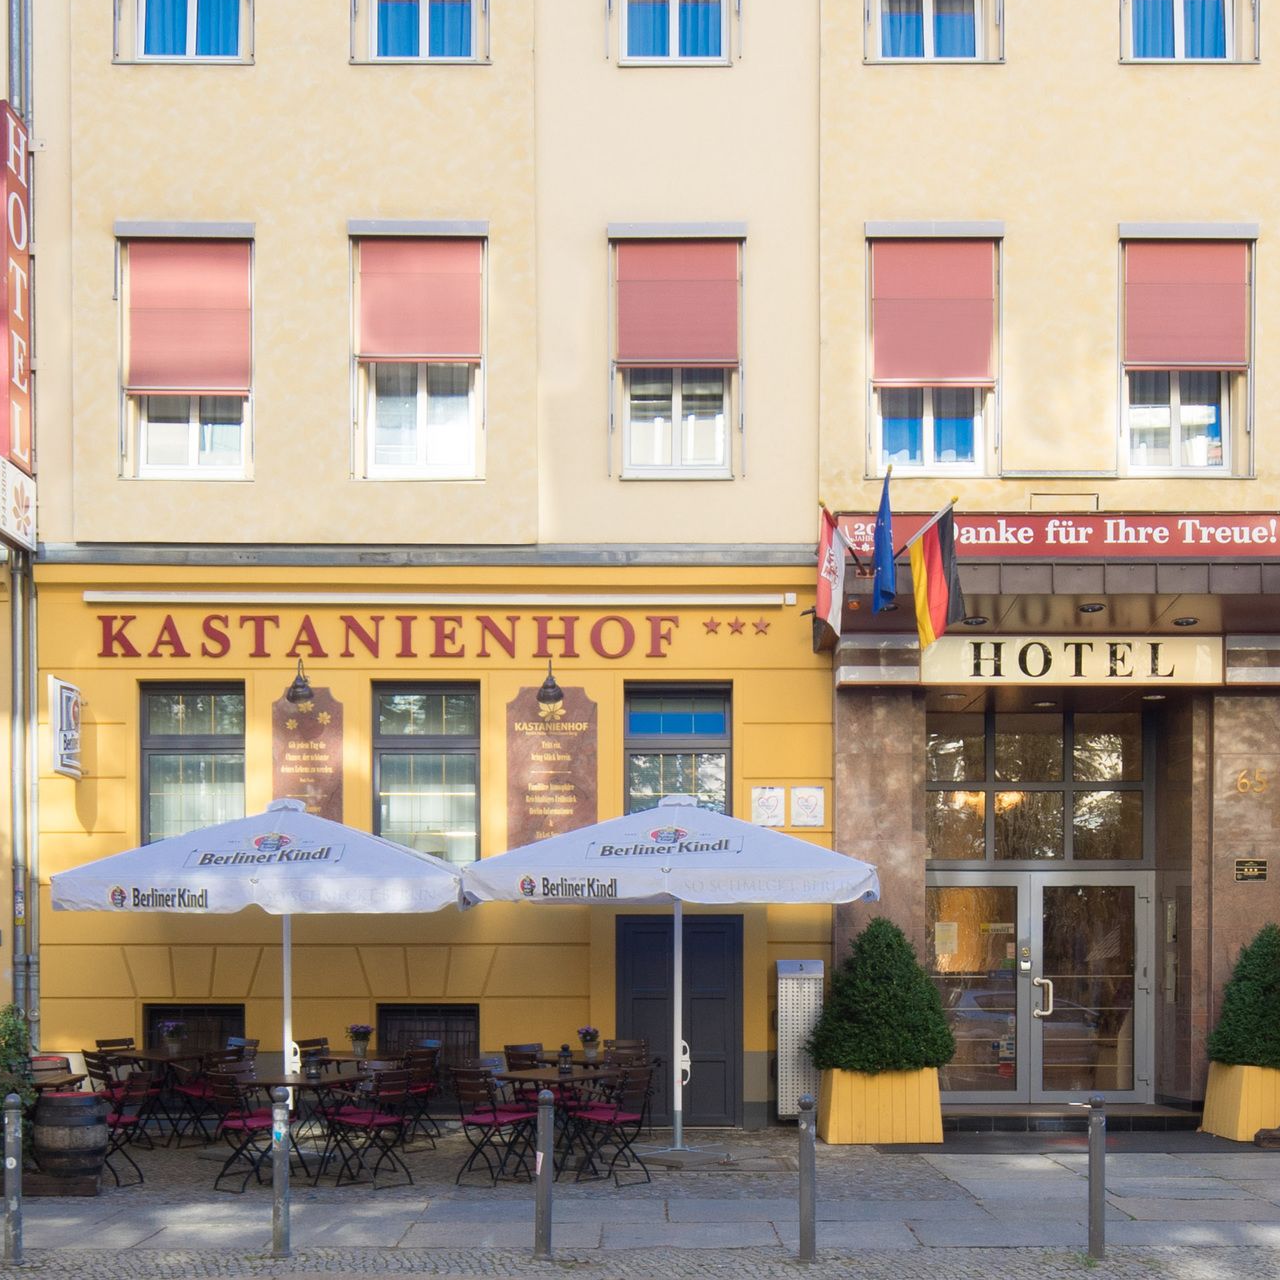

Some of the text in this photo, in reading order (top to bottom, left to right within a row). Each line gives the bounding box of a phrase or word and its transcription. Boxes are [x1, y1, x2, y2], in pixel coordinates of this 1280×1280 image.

[6, 112, 29, 463] HOTEL
[953, 519, 1278, 545] anke für Ihre Treue!
[96, 614, 680, 659] KASTANIENHOF
[968, 641, 1177, 678] HOTEL
[514, 722, 589, 731] KASTANIENHOF
[1237, 768, 1268, 793] 65
[198, 846, 332, 866] Berliner Kindl
[599, 838, 730, 857] Berliner Kindl
[132, 887, 209, 909] Berliner Kindl
[541, 877, 618, 898] Berliner Kindl
